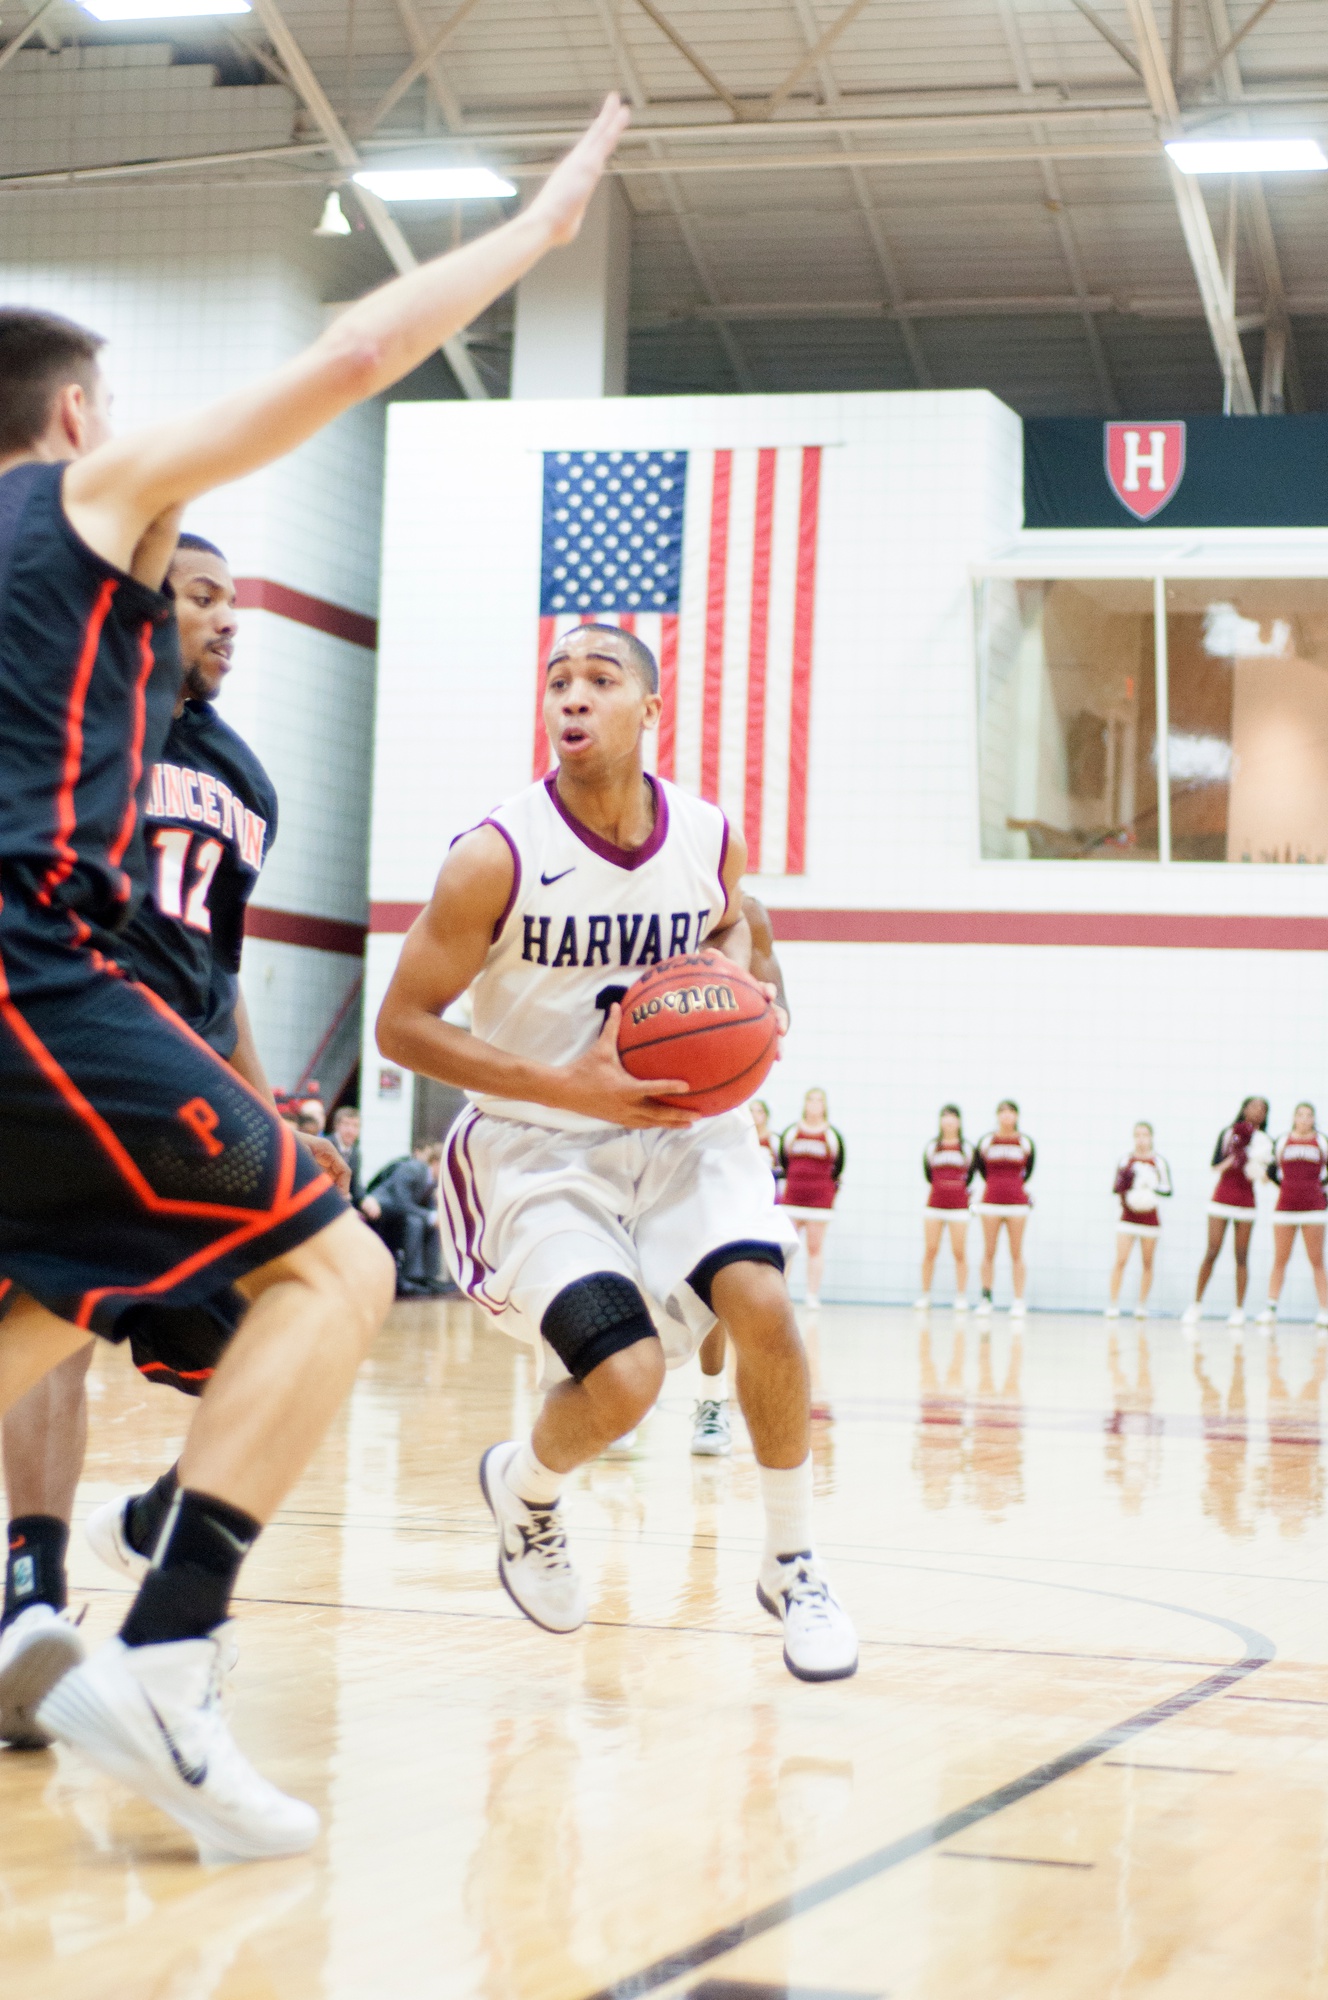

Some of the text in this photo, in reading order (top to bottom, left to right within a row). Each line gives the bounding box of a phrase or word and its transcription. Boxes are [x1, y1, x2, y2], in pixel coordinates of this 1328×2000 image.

[1122, 431, 1166, 492] H
[145, 763, 267, 872] INCETON
[152, 826, 224, 935] 12
[631, 984, 739, 1027] Wilson
[178, 1096, 225, 1156] P
